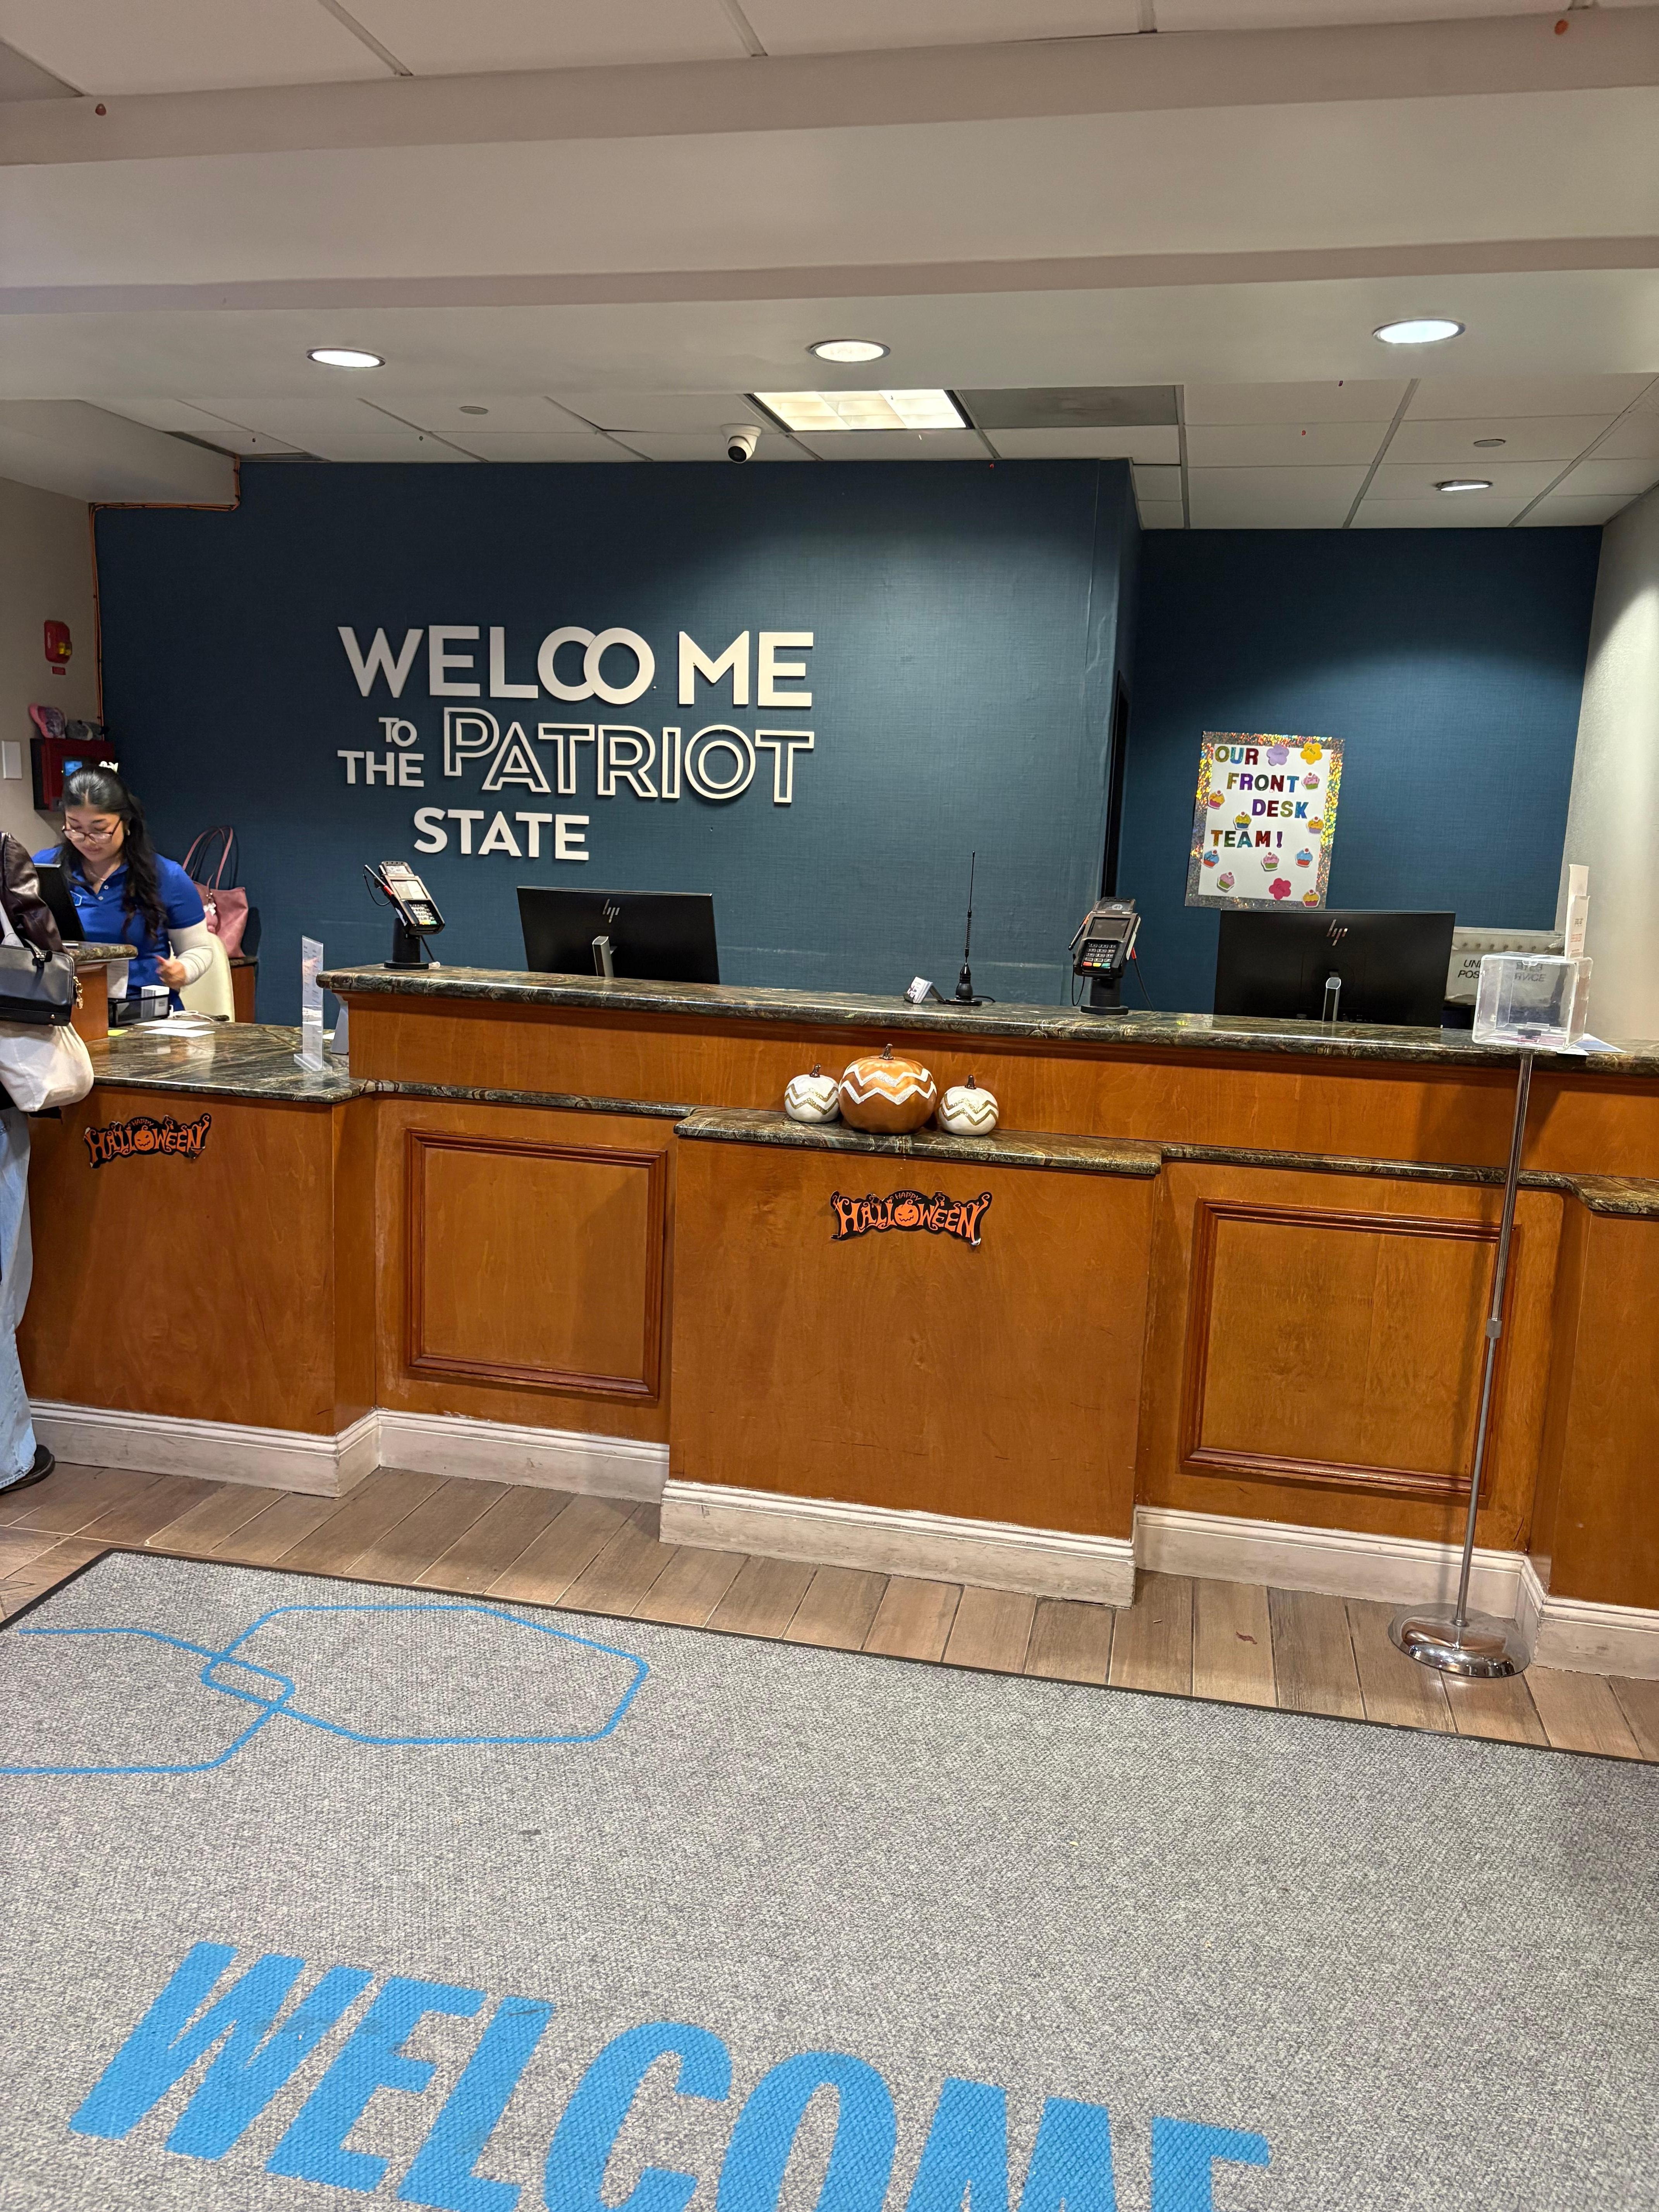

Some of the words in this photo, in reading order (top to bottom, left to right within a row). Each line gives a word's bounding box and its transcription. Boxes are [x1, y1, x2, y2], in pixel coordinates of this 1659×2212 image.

[379, 717, 417, 747] TO
[443, 707, 814, 804] PATRIOT
[1214, 745, 1259, 765] OUR
[337, 750, 424, 787] THE
[1226, 772, 1299, 793] FRONT
[1252, 799, 1309, 819] DESK
[414, 807, 589, 860] STATE
[1211, 830, 1283, 848] TEAM!
[1463, 959, 1481, 968] UNI
[1458, 970, 1480, 979] POS
[84, 1115, 209, 1163] HALLOWEEN
[895, 1192, 921, 1201] HAPPY
[833, 1194, 990, 1243] HALLOWEEN
